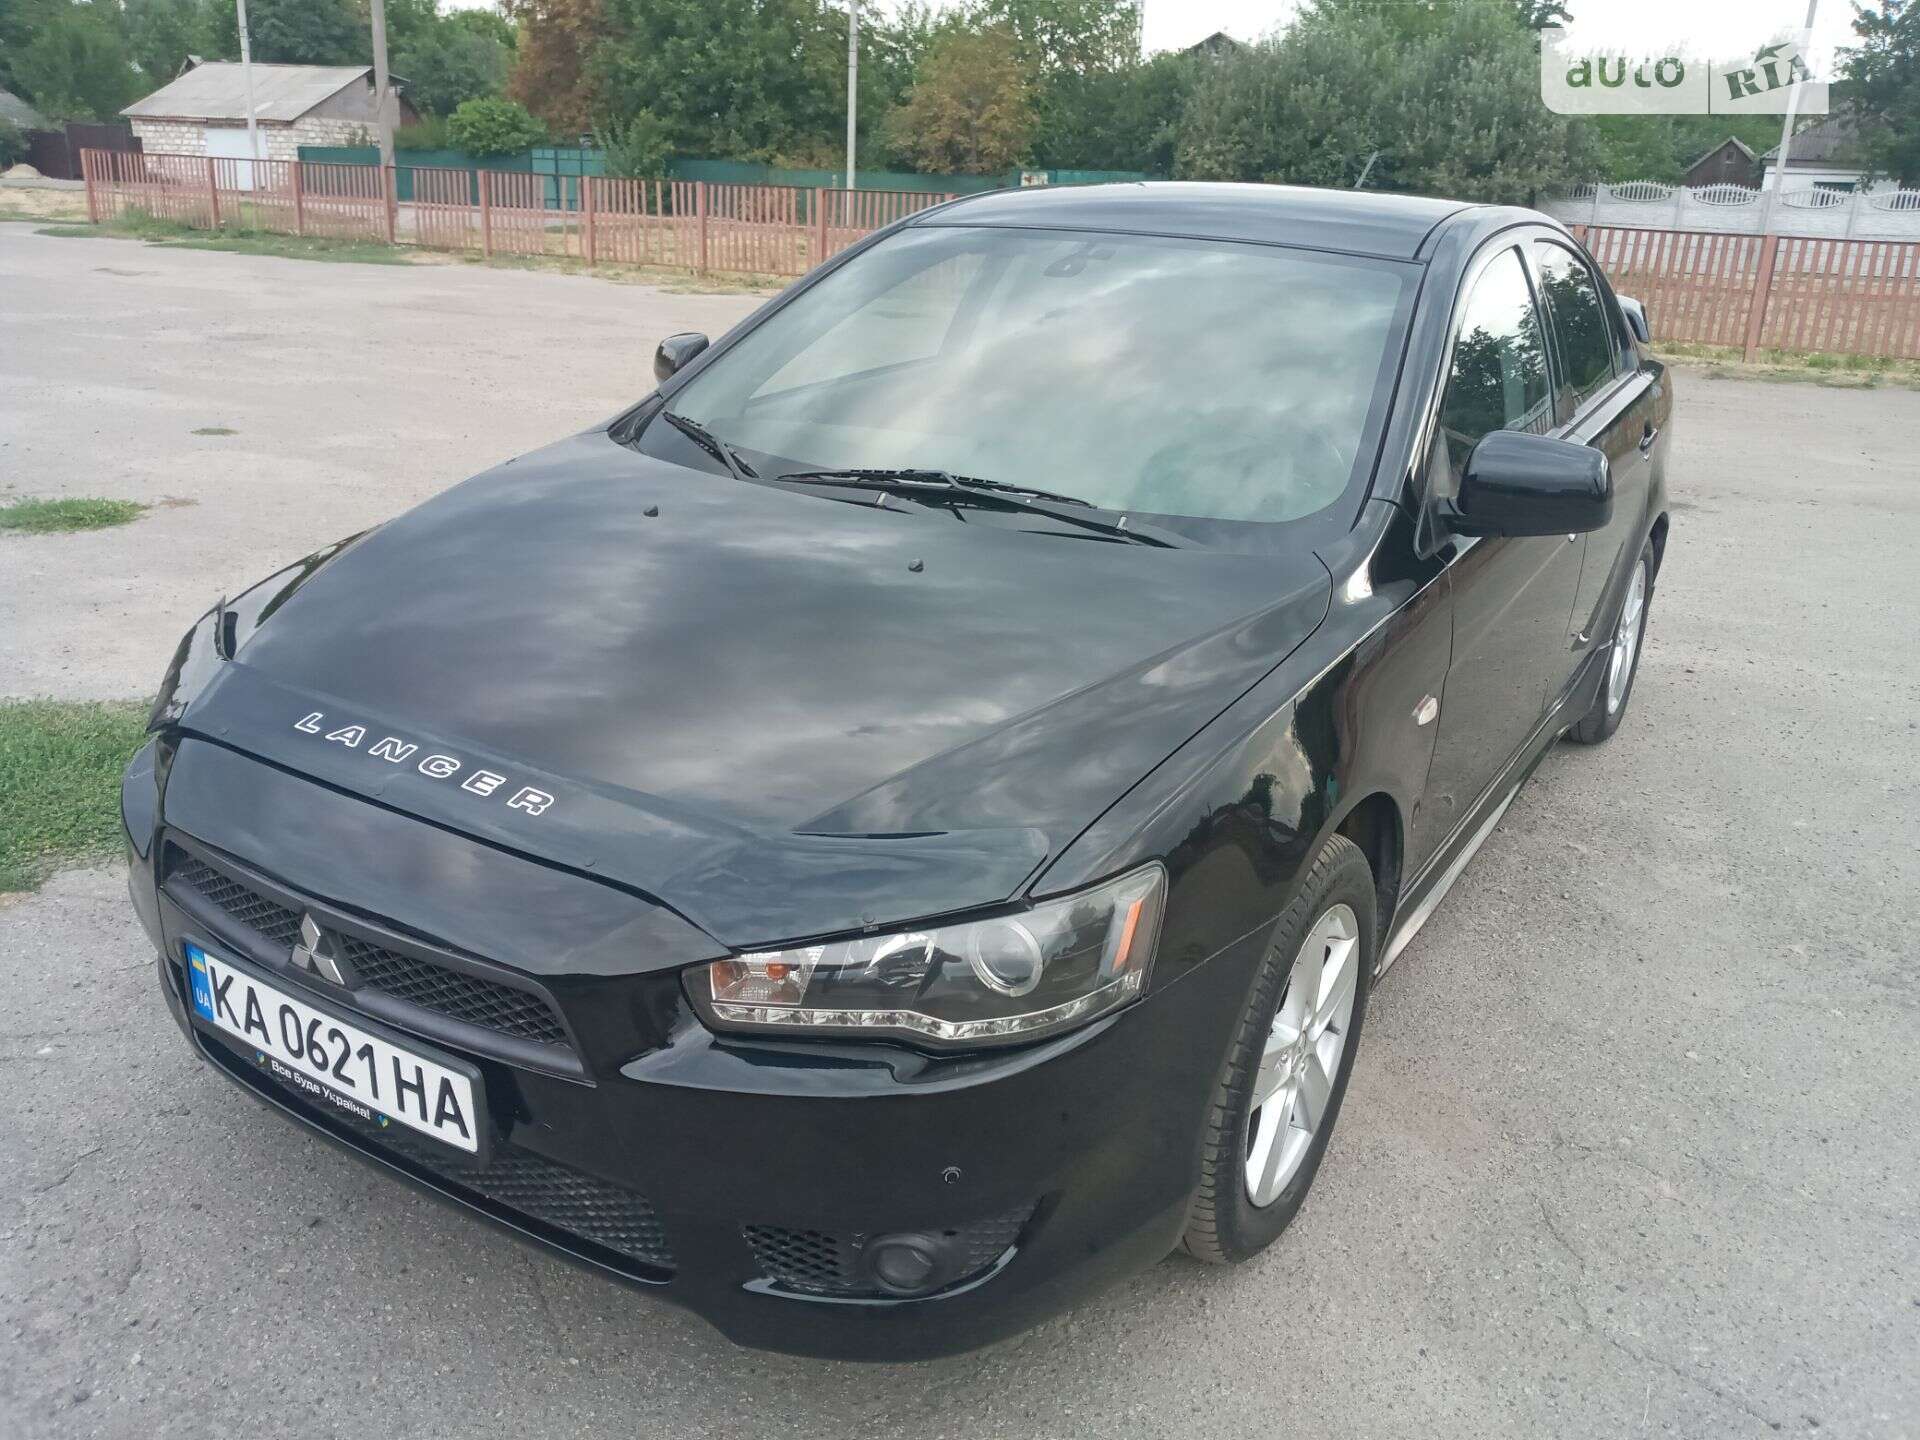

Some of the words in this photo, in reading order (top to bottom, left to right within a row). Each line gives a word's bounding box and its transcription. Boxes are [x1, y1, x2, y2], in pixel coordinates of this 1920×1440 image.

[294, 712, 555, 816] LANCER
[195, 987, 212, 1010] UA
[210, 966, 272, 1046] KA
[279, 1003, 380, 1100] 0621
[392, 1055, 475, 1139] HA
